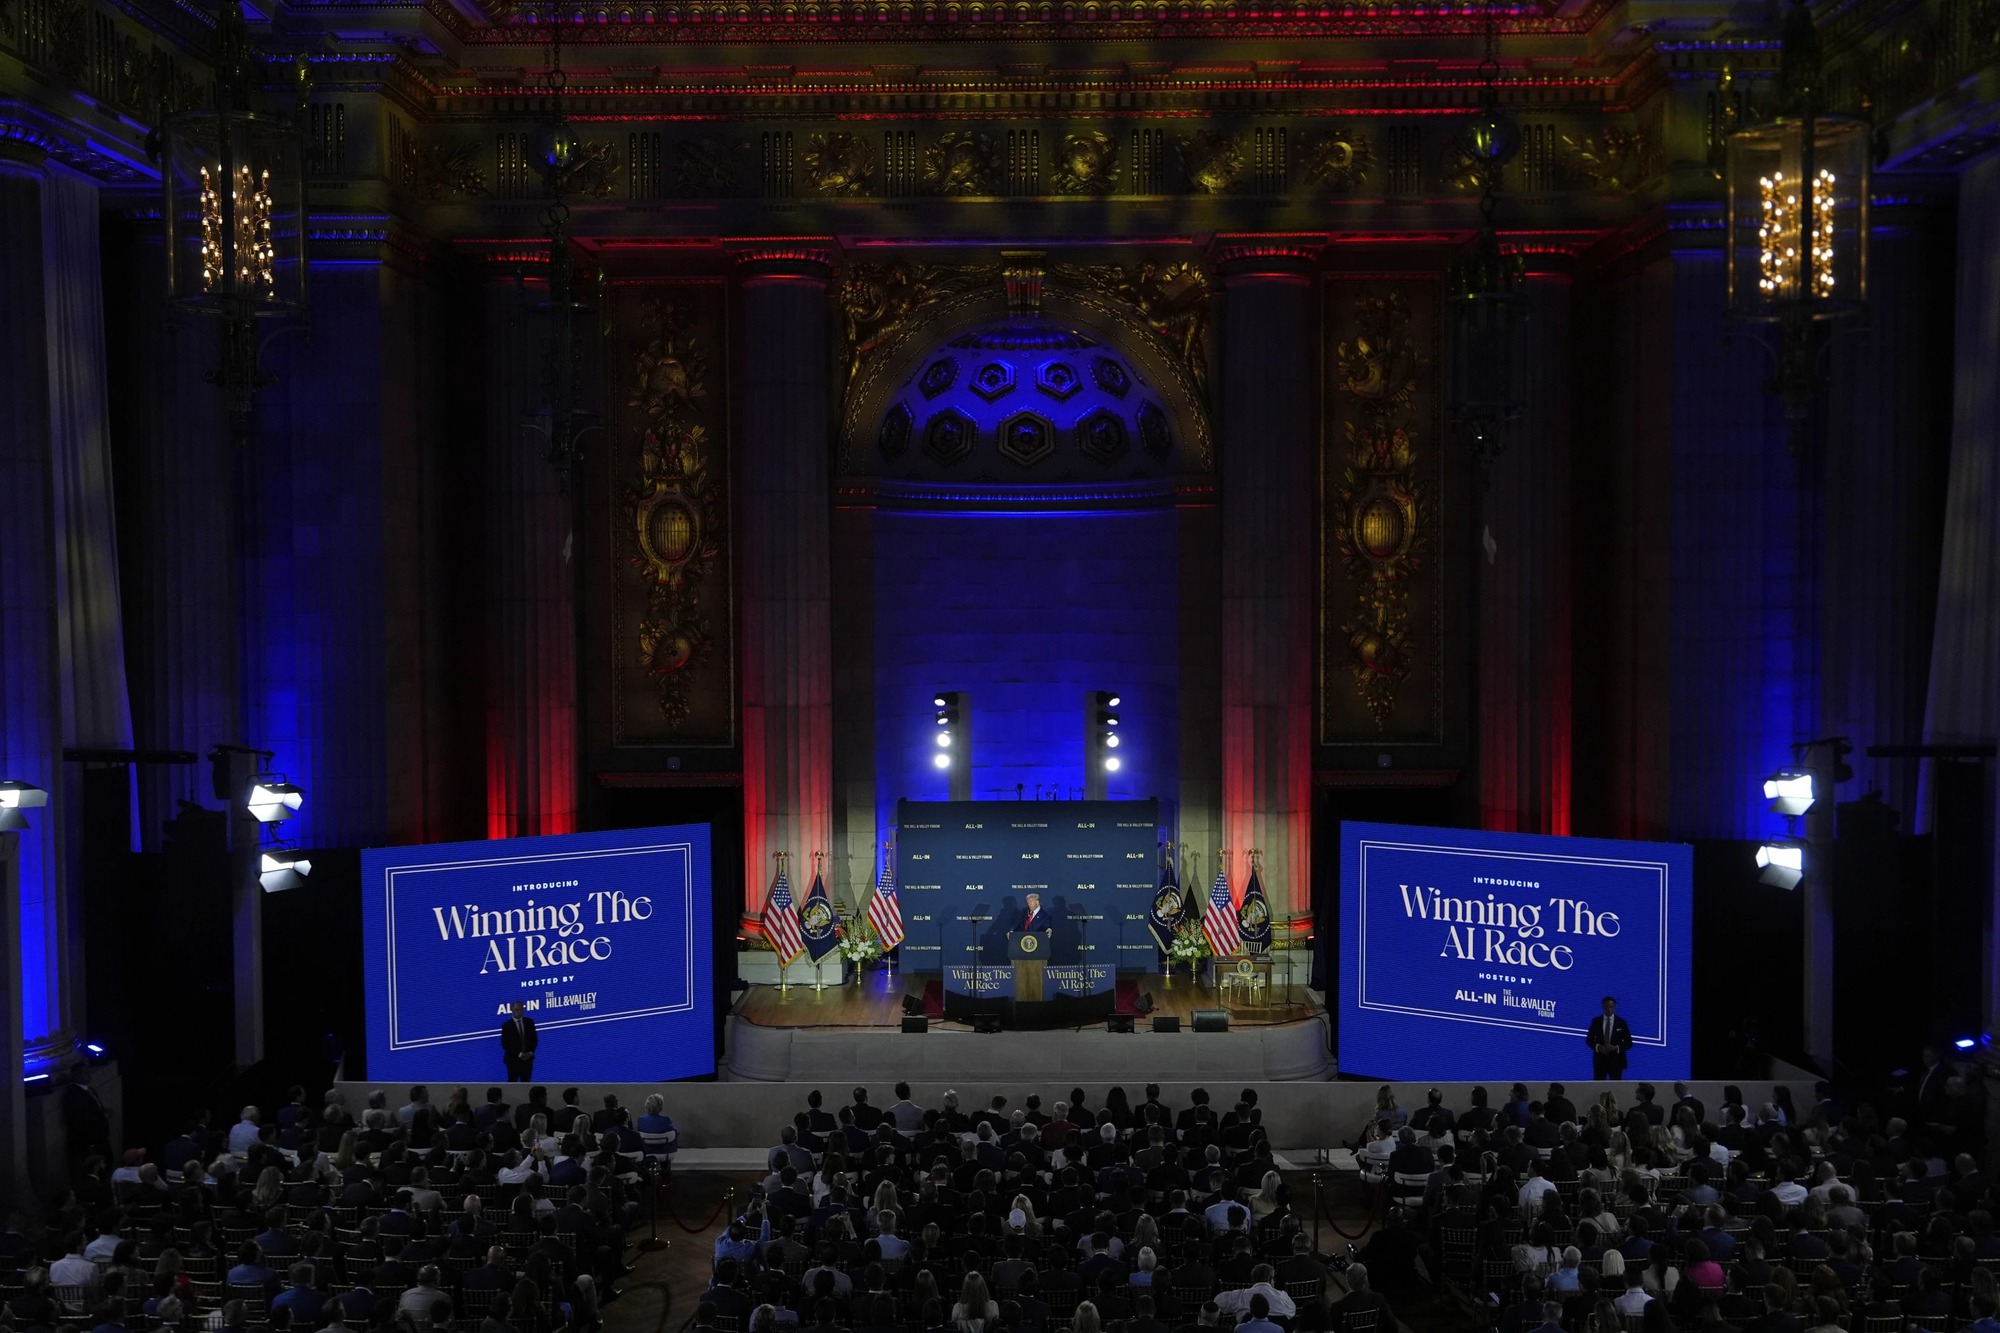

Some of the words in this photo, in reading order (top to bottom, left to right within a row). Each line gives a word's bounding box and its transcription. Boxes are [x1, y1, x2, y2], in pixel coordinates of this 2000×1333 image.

[512, 879, 579, 892] INTRODUCING
[1473, 876, 1540, 889] INTRODUCING
[432, 900, 585, 940] Winning
[587, 890, 653, 925] The
[1398, 884, 1545, 938] Winning
[1548, 897, 1621, 938] The
[479, 937, 517, 974] AI
[524, 934, 613, 969] Race
[1439, 925, 1476, 961] AI
[1483, 928, 1574, 971] Race
[993, 969, 1012, 979] The
[1088, 968, 1106, 978] The
[1478, 972, 1516, 983] HOSTED
[1520, 977, 1533, 985] BY
[521, 978, 558, 988] HOSTED
[964, 980, 974, 990] AI
[975, 980, 1000, 990] Race
[1059, 980, 1069, 990] AI
[1454, 990, 1497, 1004] ALL-IN
[496, 1000, 540, 1015] AL-IN
[1538, 1009, 1555, 1018] FORUM
